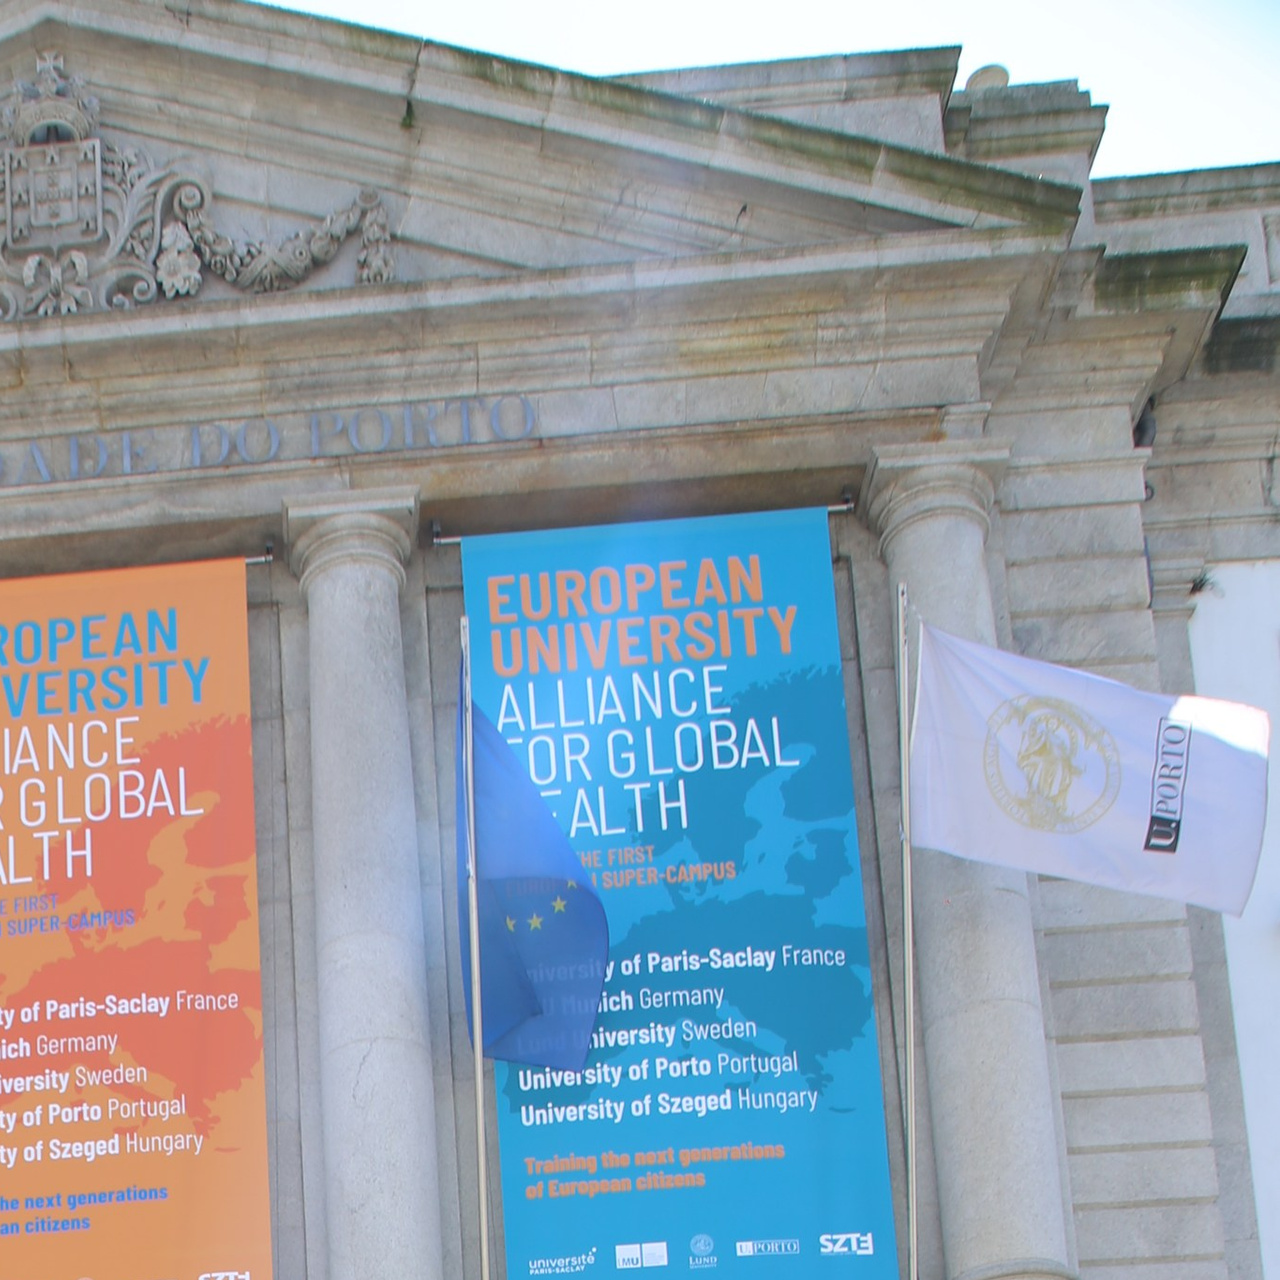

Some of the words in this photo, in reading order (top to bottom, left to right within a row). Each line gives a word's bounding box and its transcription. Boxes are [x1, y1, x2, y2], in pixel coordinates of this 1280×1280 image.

[190, 419, 280, 467] DO
[310, 395, 536, 457] PORTO
[487, 554, 763, 624] EUROPEAN
[490, 605, 798, 677] UNIVERSITY
[497, 664, 731, 733] ALLIANCE
[607, 717, 800, 779] GLOBAL
[20, 767, 204, 828] GLOBAL
[540, 779, 688, 838] ALTH
[608, 845, 655, 865] FIRST
[602, 861, 737, 890] SUPER-CAMPUS
[14, 893, 59, 913] FIRST
[8, 909, 136, 937] SUPER-CAMPUS
[621, 954, 641, 975] of
[648, 946, 776, 973] Paris-Saclay
[782, 945, 846, 966] France
[20, 1001, 40, 1023] of
[46, 992, 170, 1020] Paris-Saclay
[176, 990, 239, 1011] France
[640, 988, 724, 1010] Germany
[37, 1033, 118, 1056] Germany
[682, 1017, 757, 1042] Sweden
[75, 1064, 147, 1087] Sweden
[519, 1062, 622, 1091] University
[628, 1059, 649, 1080] of
[655, 1055, 712, 1078] Porto
[718, 1051, 798, 1076] Portugal
[23, 1104, 43, 1126] of
[49, 1099, 102, 1124] Porto
[108, 1094, 186, 1120] Portugal
[521, 1098, 624, 1126] University
[631, 1094, 651, 1115] of
[658, 1089, 732, 1115] Szeged
[738, 1087, 818, 1112] Hungary
[23, 1139, 44, 1161] of
[49, 1134, 120, 1163] Szeged
[126, 1132, 203, 1155] Hungary
[524, 1153, 597, 1174] Training
[601, 1151, 630, 1168] the
[635, 1148, 674, 1166] next
[679, 1141, 785, 1167] generations
[25, 1193, 62, 1211] next
[67, 1185, 168, 1207] generations
[525, 1181, 543, 1199] of
[548, 1177, 631, 1198] European
[636, 1171, 706, 1190] citizens
[25, 1216, 90, 1234] citizens
[529, 1264, 586, 1275] PARIS-SACLAY
